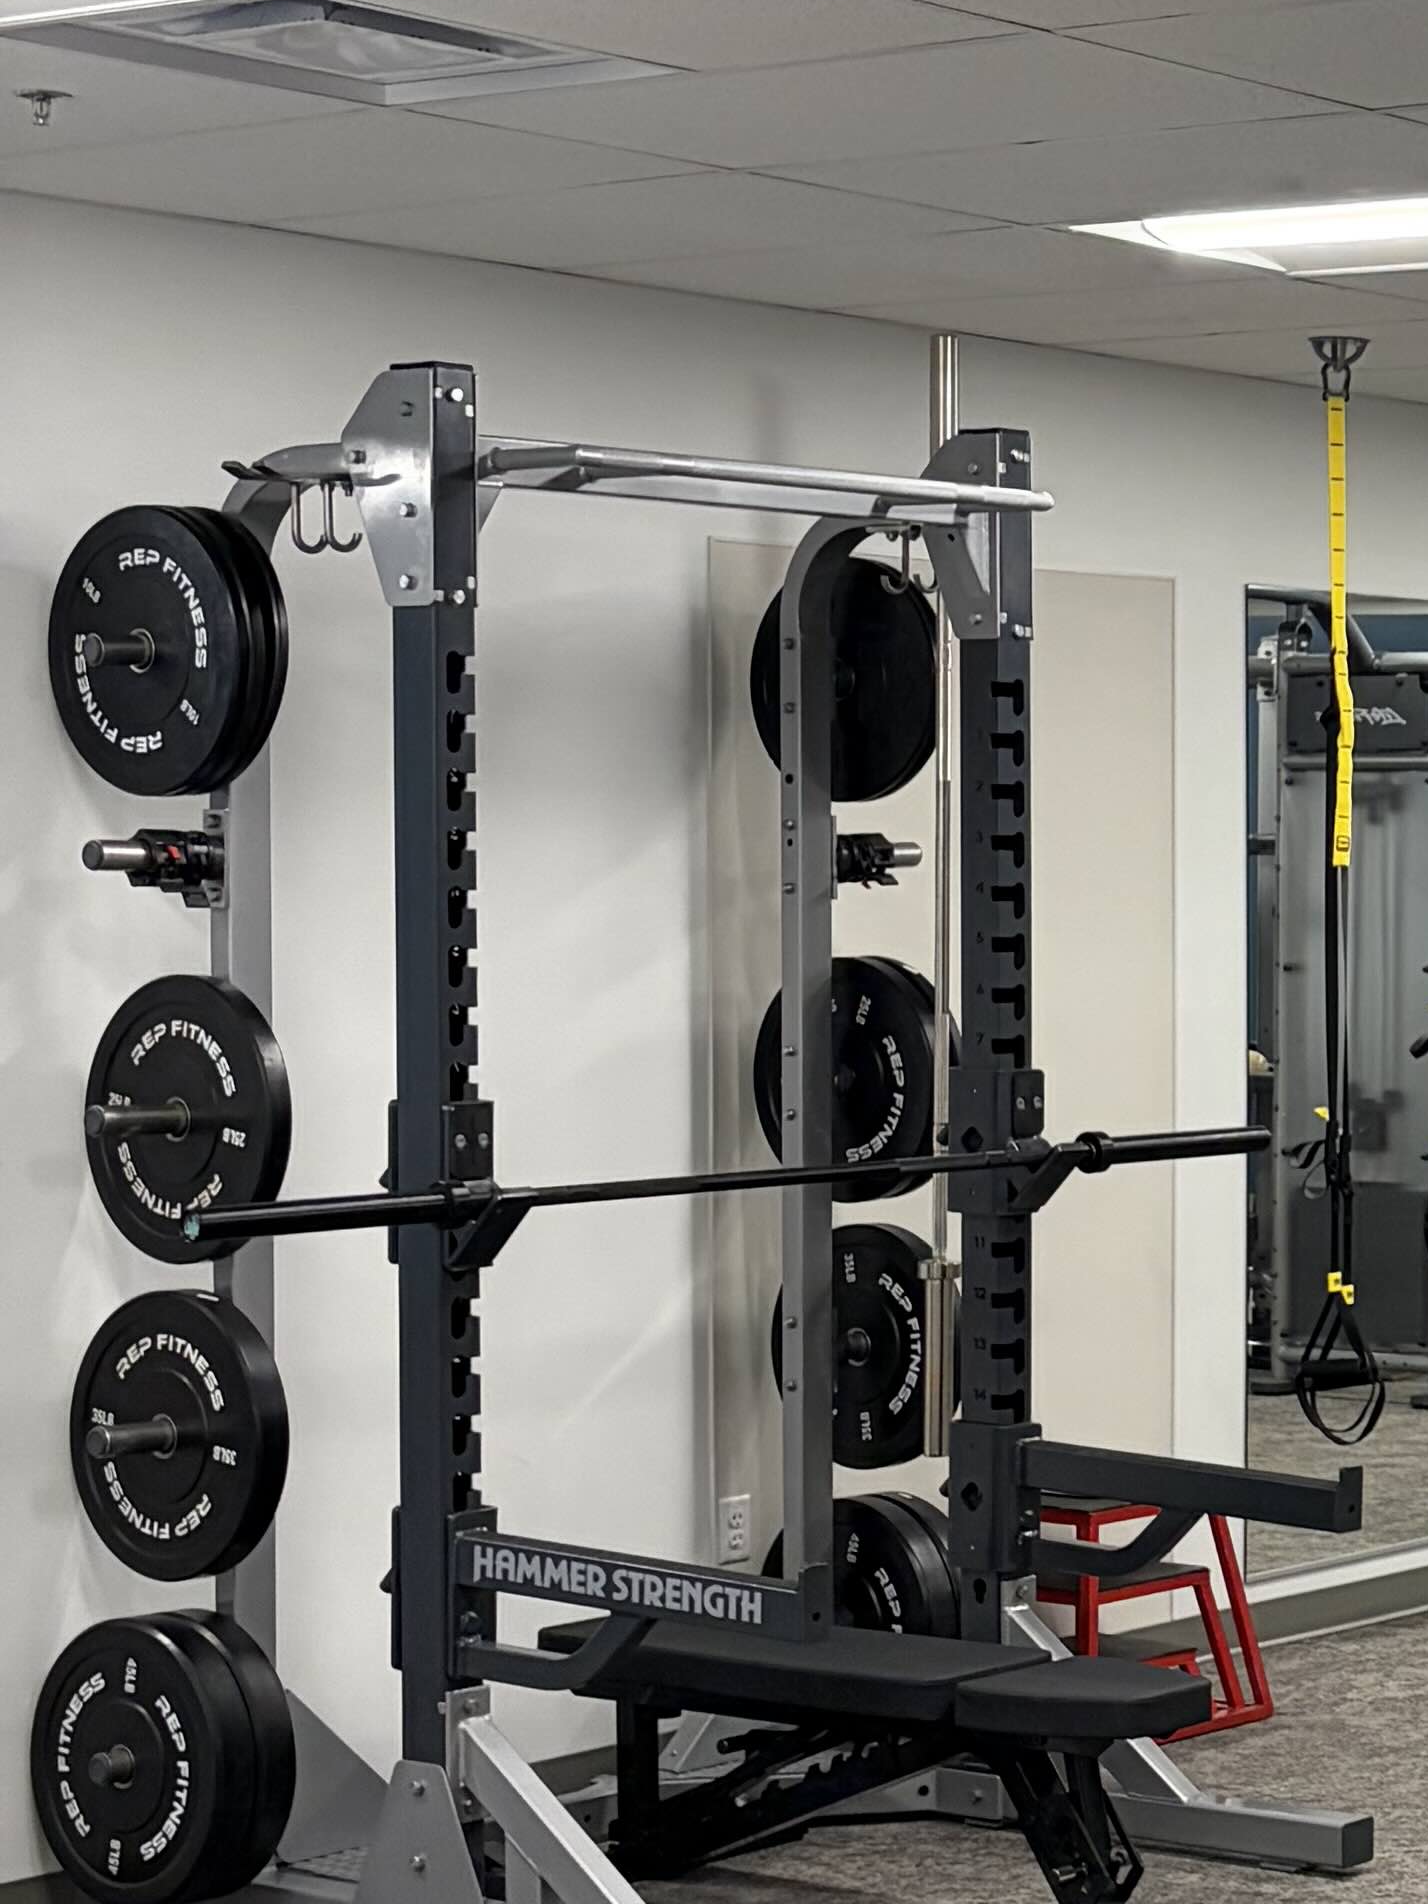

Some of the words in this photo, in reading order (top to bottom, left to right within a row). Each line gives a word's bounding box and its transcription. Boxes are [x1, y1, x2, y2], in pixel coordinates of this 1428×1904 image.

[118, 548, 160, 571] REP
[162, 557, 208, 669] FITNESS
[75, 633, 118, 744] FITNESS
[120, 730, 163, 754] REP
[855, 995, 872, 1025] 25LB
[130, 1023, 167, 1066] REP
[171, 1020, 236, 1097] FITNESS
[882, 1035, 905, 1087] REP
[222, 1127, 246, 1148] 25LB
[845, 1092, 904, 1163] FITNESS
[117, 1142, 182, 1219] FITNESS
[878, 1273, 913, 1313] REP
[116, 1336, 152, 1380] REP
[157, 1333, 225, 1412] FITNESS
[888, 1316, 921, 1416] FITNESS
[213, 1445, 237, 1466] 35LB
[103, 1461, 171, 1540] FITNESS
[174, 1493, 212, 1537] REP
[473, 1545, 607, 1598] HAMMER
[612, 1569, 762, 1624] STRENGTH
[874, 1567, 902, 1617] REP
[124, 1657, 137, 1694] 45LB
[57, 1672, 106, 1772] FITNESS
[154, 1695, 187, 1753] REP
[60, 1780, 91, 1837] REP
[139, 1760, 190, 1862] FITNESS
[108, 1839, 121, 1876] 45LB
